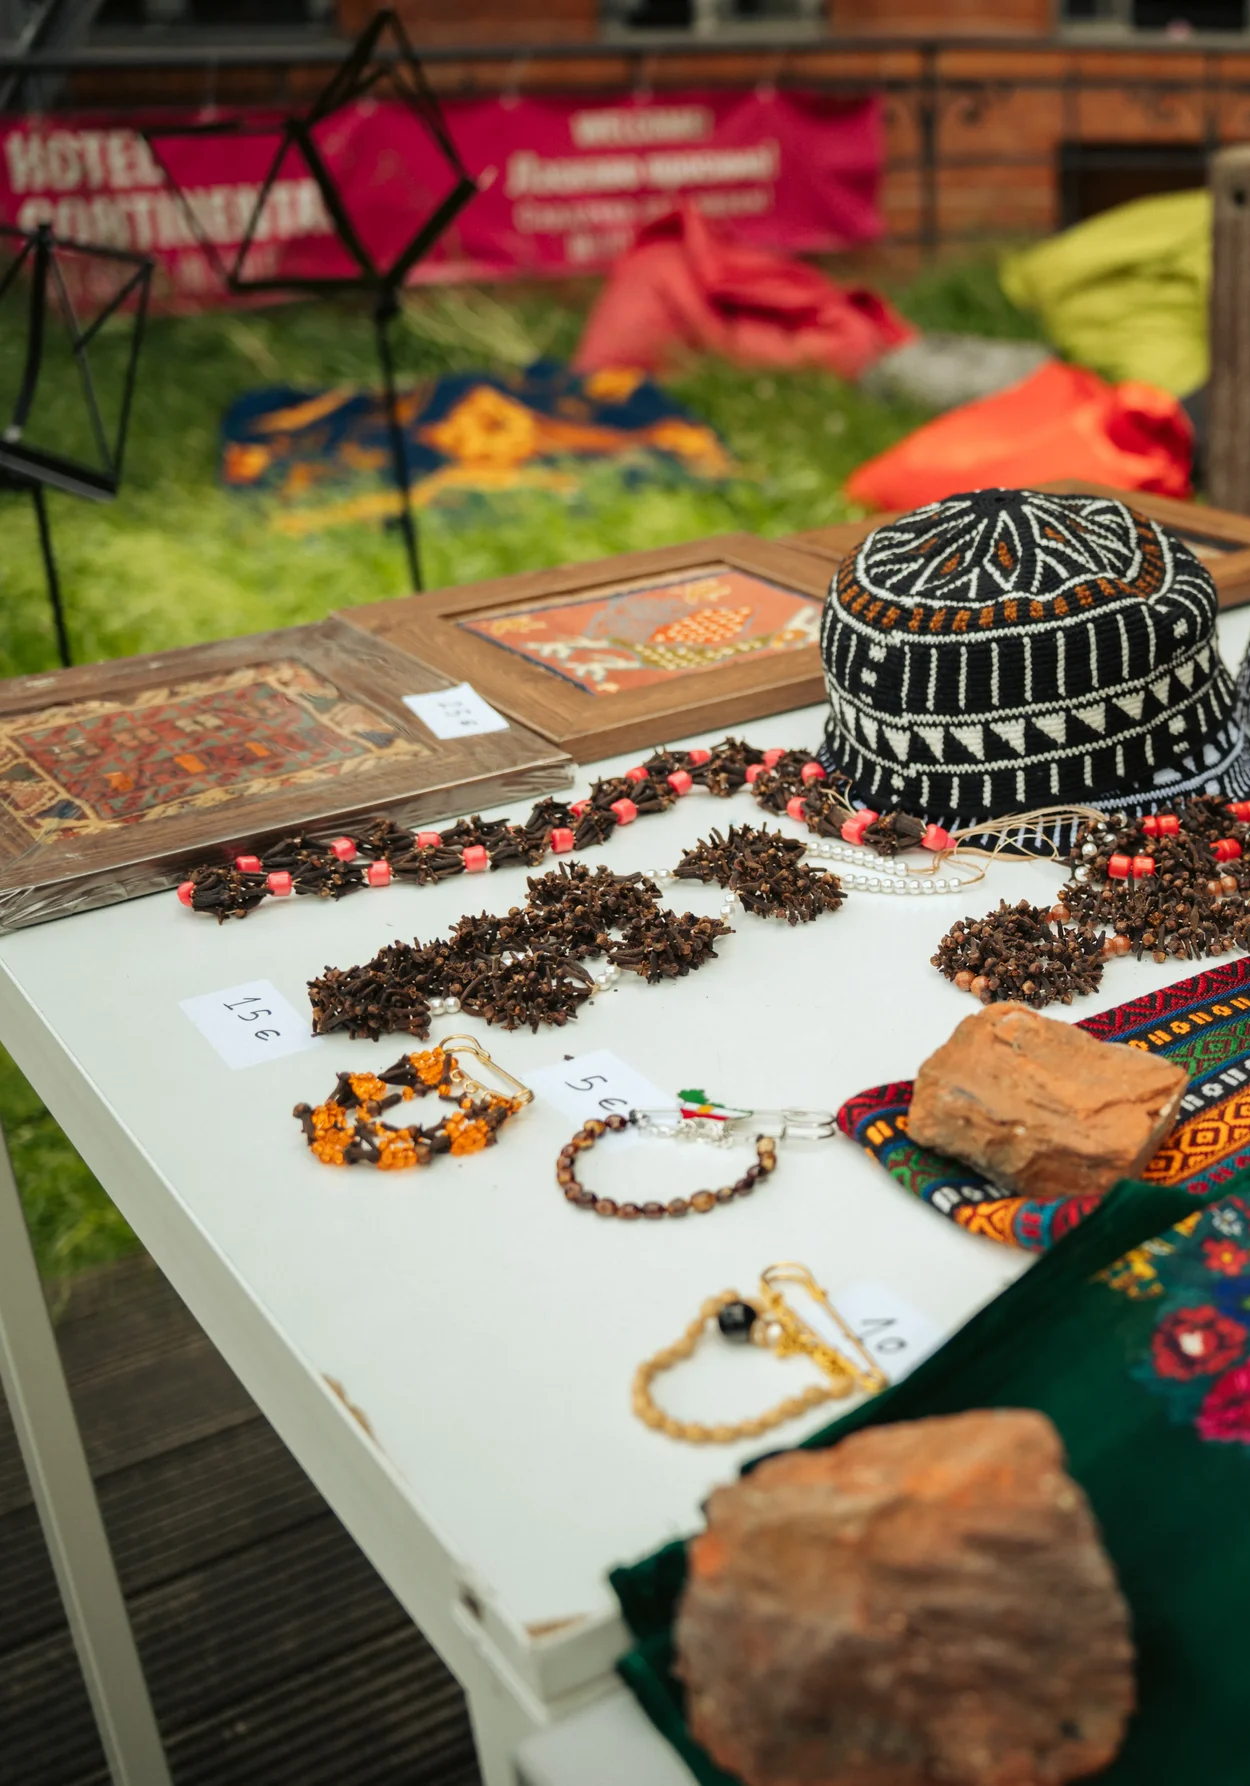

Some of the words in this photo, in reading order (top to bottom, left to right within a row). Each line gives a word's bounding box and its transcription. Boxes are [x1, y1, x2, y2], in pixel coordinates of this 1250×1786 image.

[6, 129, 163, 191] HOTEL
[17, 178, 336, 251] CONTINENTA
[222, 997, 272, 1021] 15
[254, 1029, 281, 1041] €
[564, 1075, 608, 1091] 5
[598, 1097, 628, 1112] €
